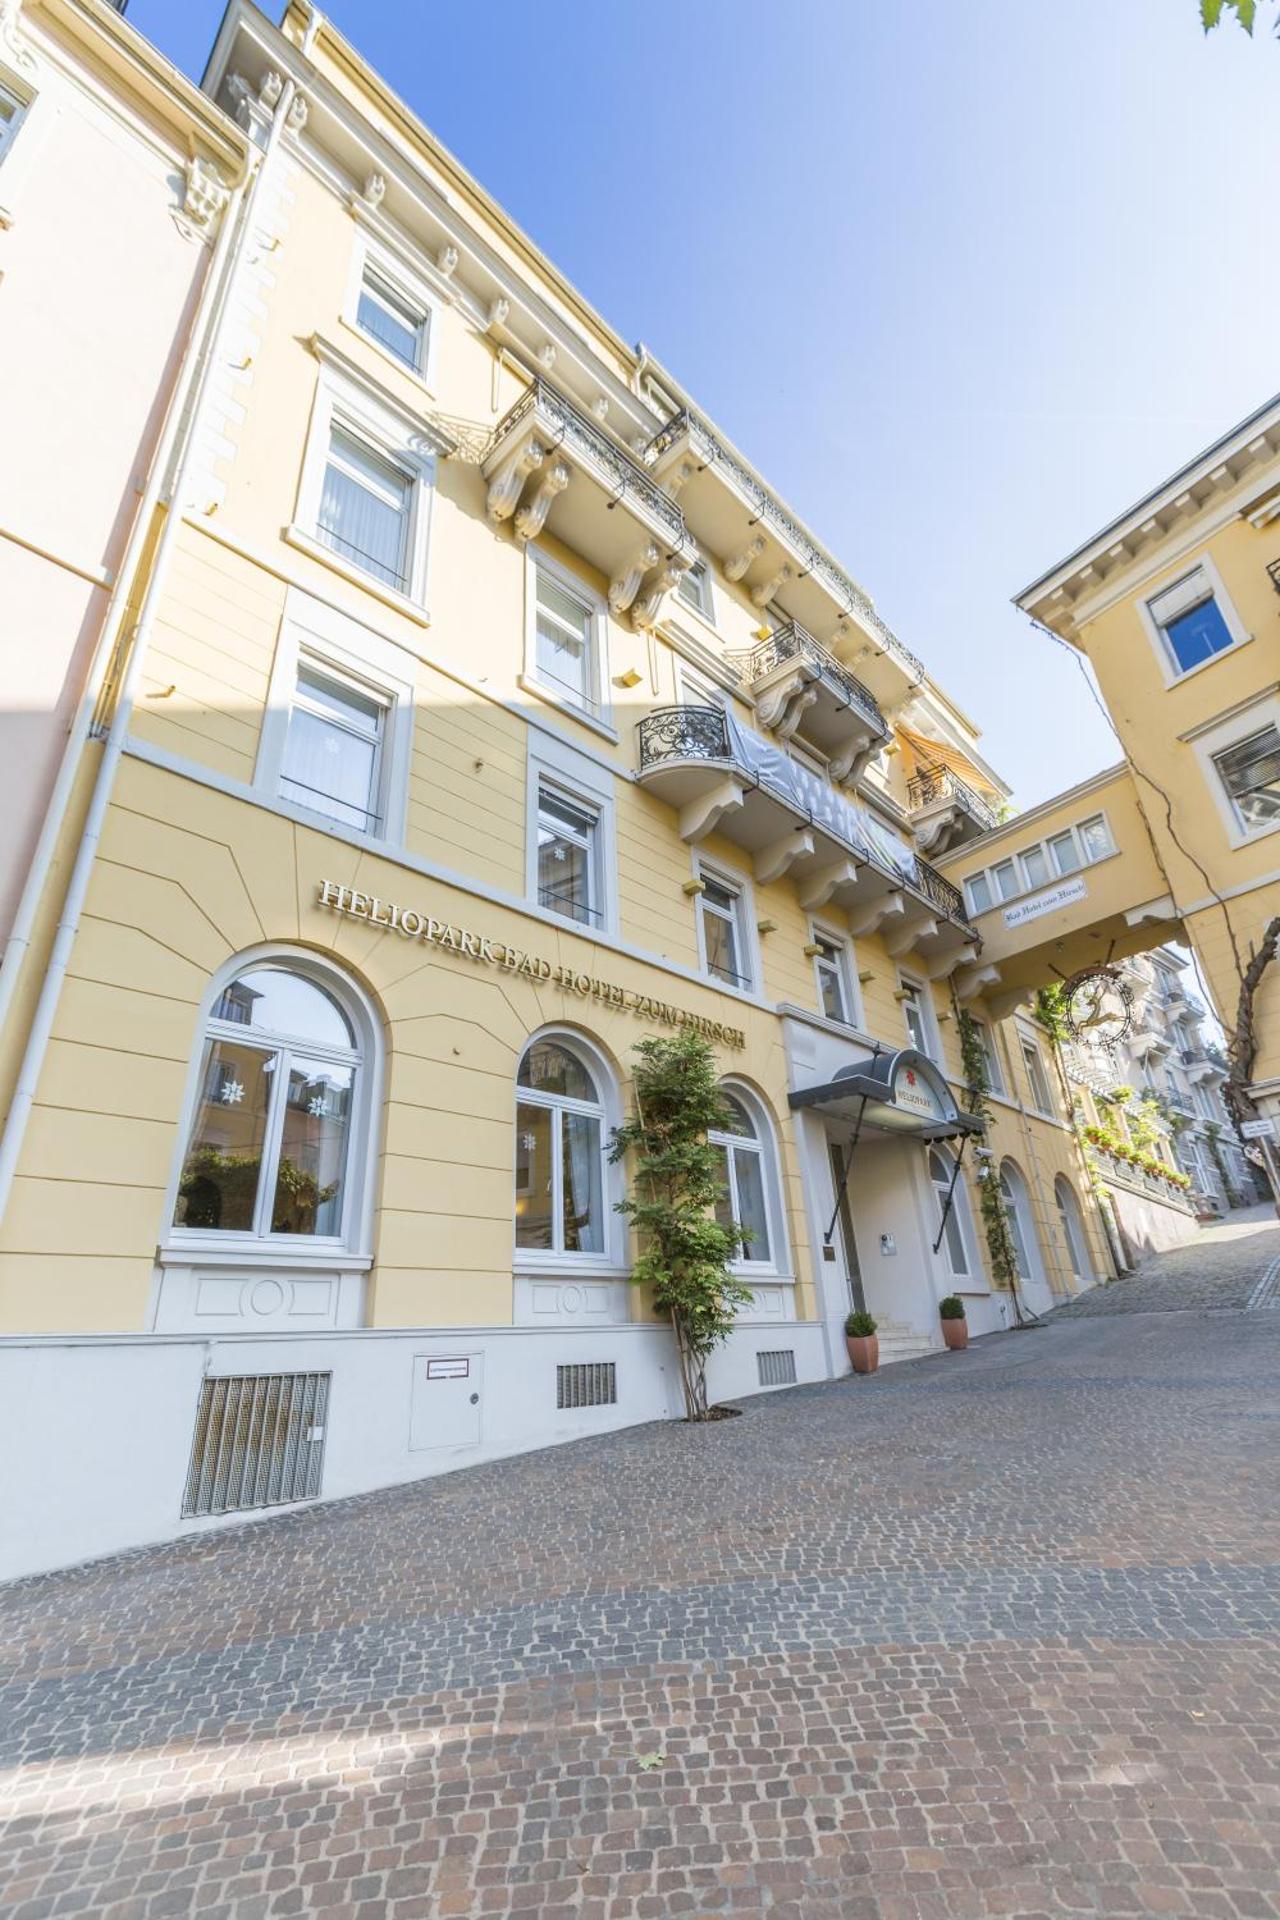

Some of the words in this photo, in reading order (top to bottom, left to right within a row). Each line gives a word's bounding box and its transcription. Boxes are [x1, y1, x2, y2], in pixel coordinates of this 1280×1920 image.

[317, 879, 497, 964] HELIOPARK
[502, 947, 553, 982] BAD
[558, 965, 633, 1011] HOTEL
[635, 994, 679, 1026] ZUM
[681, 1009, 747, 1050] HIRSCH
